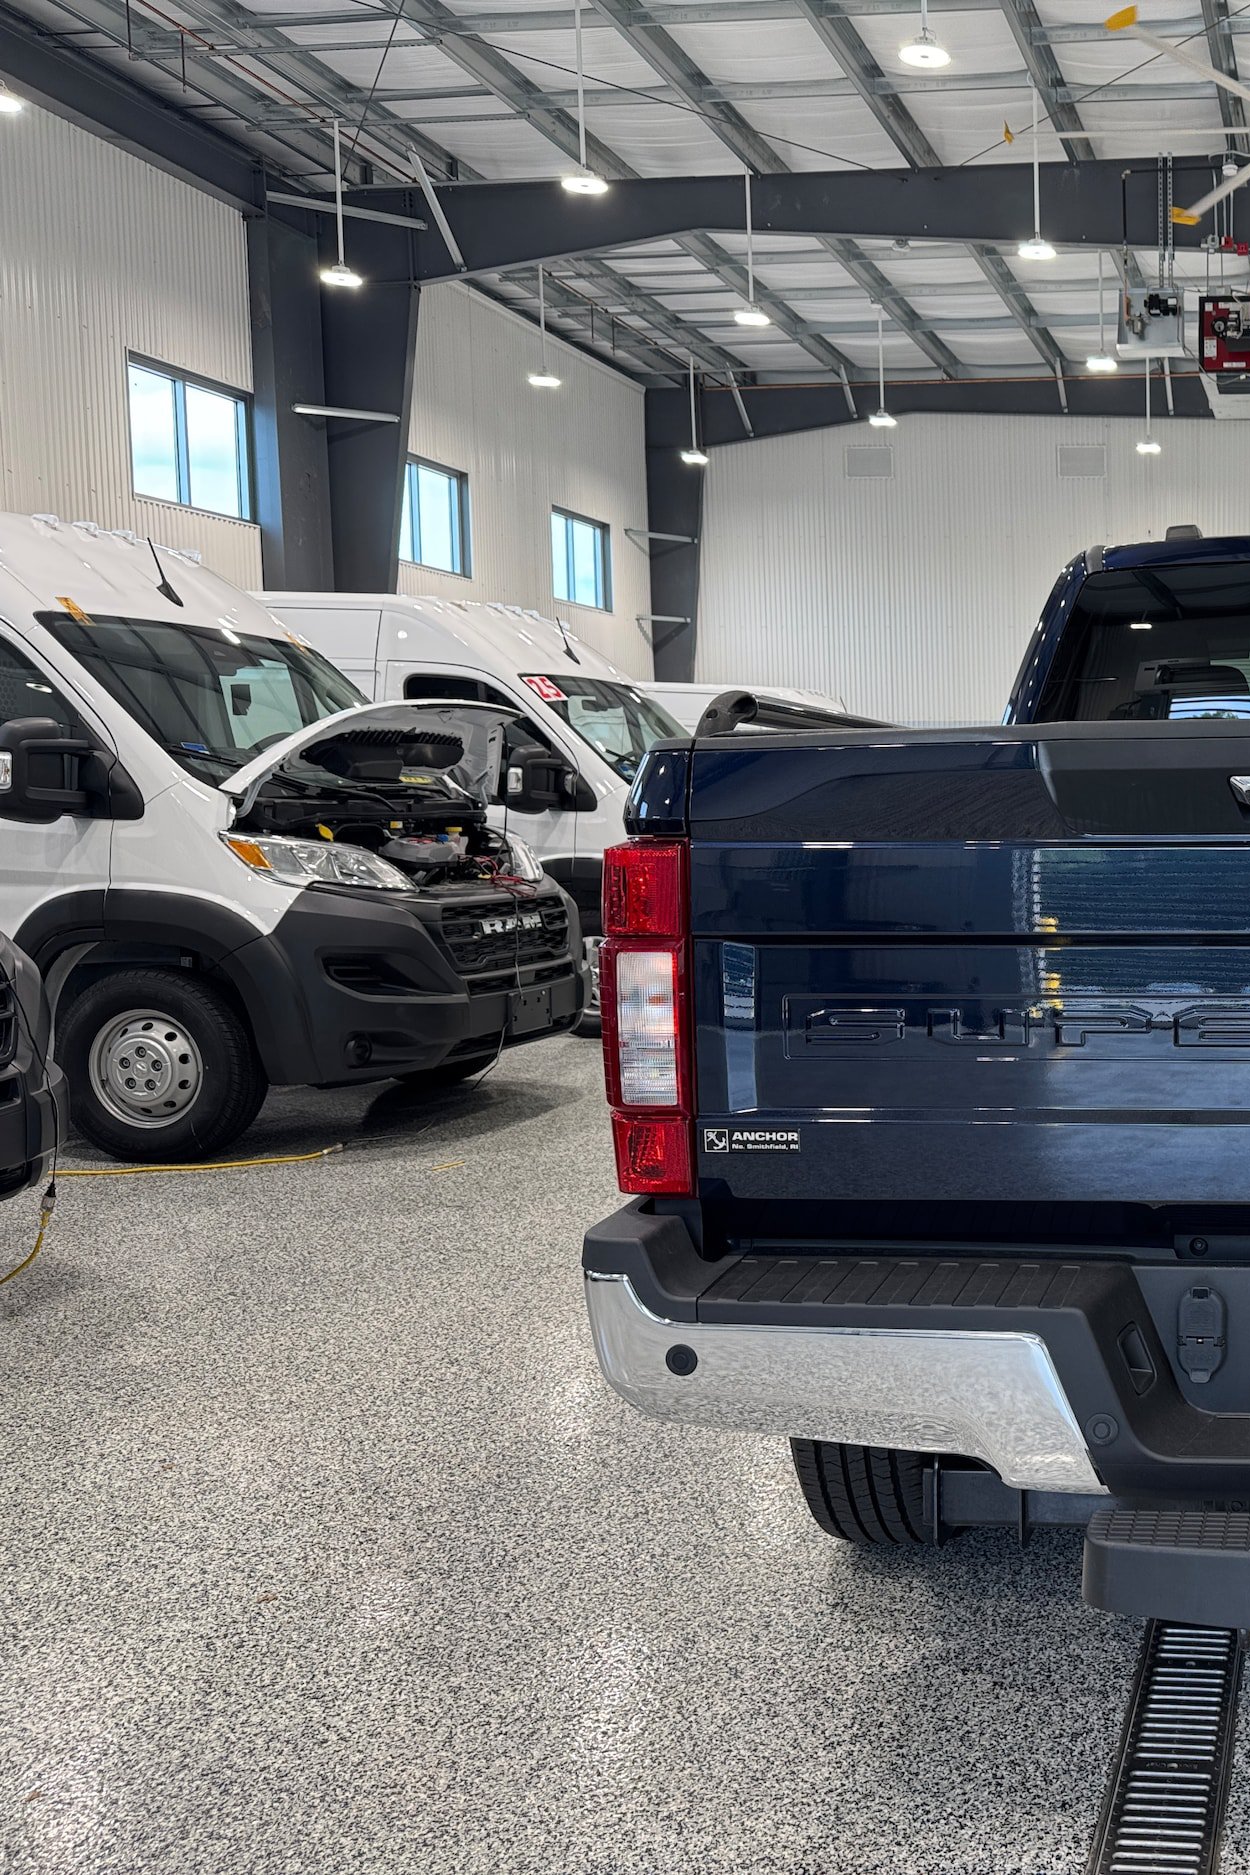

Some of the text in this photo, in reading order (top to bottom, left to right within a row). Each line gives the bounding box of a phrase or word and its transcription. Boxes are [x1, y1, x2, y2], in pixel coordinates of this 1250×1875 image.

[526, 677, 562, 699] 25
[481, 912, 543, 935] RAM
[731, 1131, 799, 1141] ANCHOR
